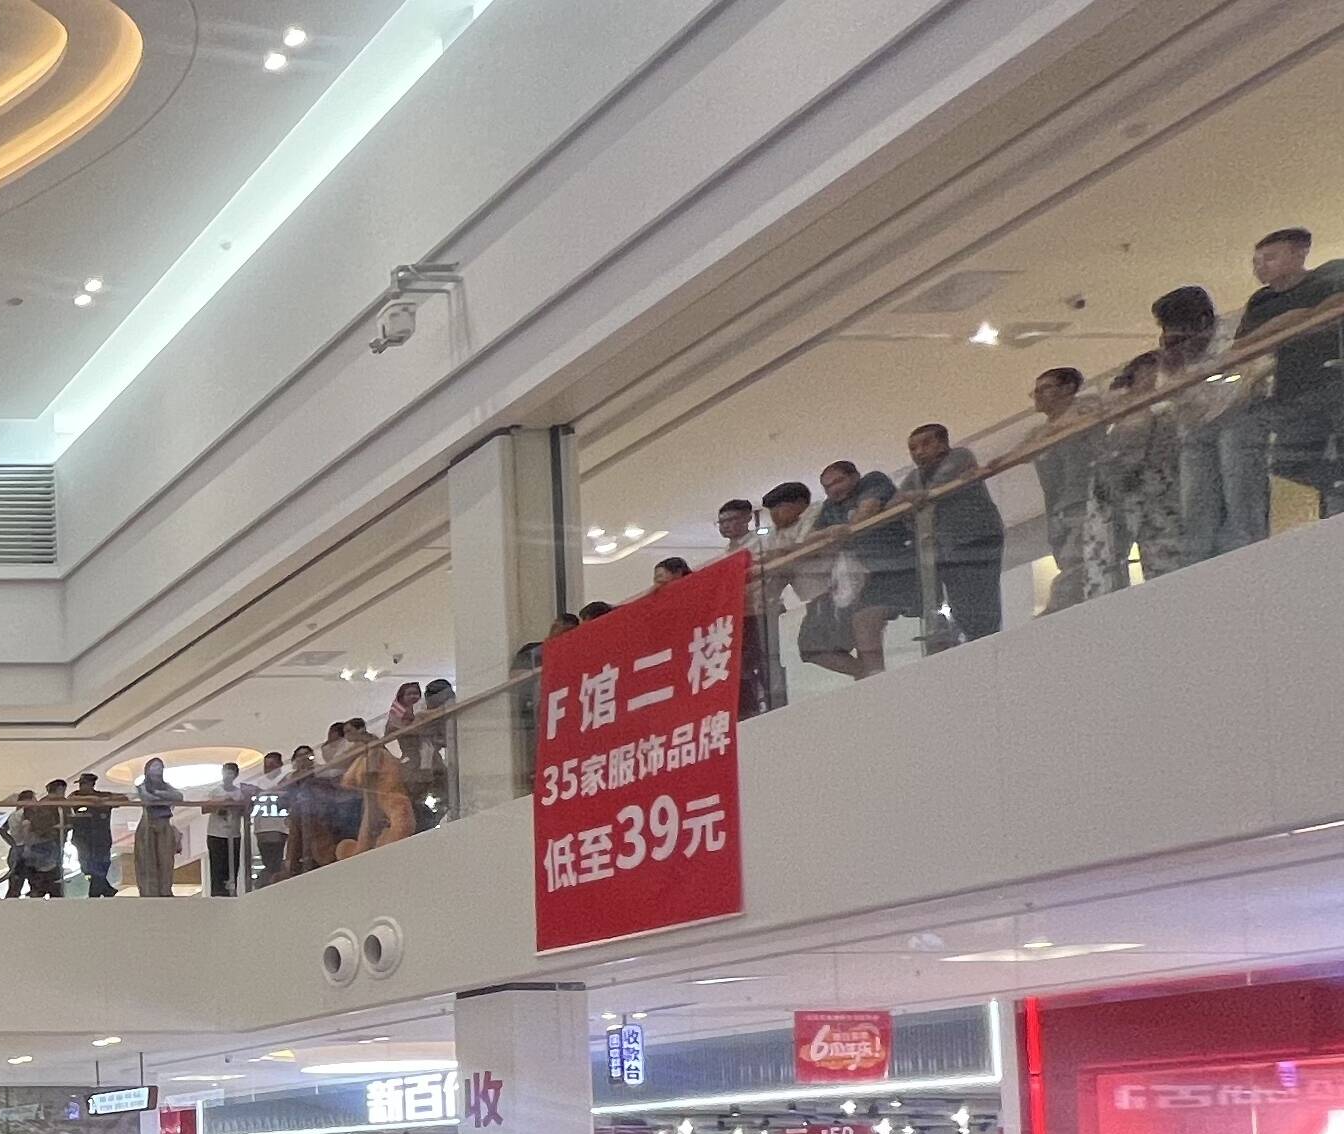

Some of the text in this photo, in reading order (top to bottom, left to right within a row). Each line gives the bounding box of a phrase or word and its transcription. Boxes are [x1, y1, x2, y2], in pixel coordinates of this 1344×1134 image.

[546, 613, 735, 741] F馆二楼
[541, 710, 731, 807] 35家服饰品牌
[543, 794, 726, 892] 低至39元
[623, 1029, 641, 1081] 收款台
